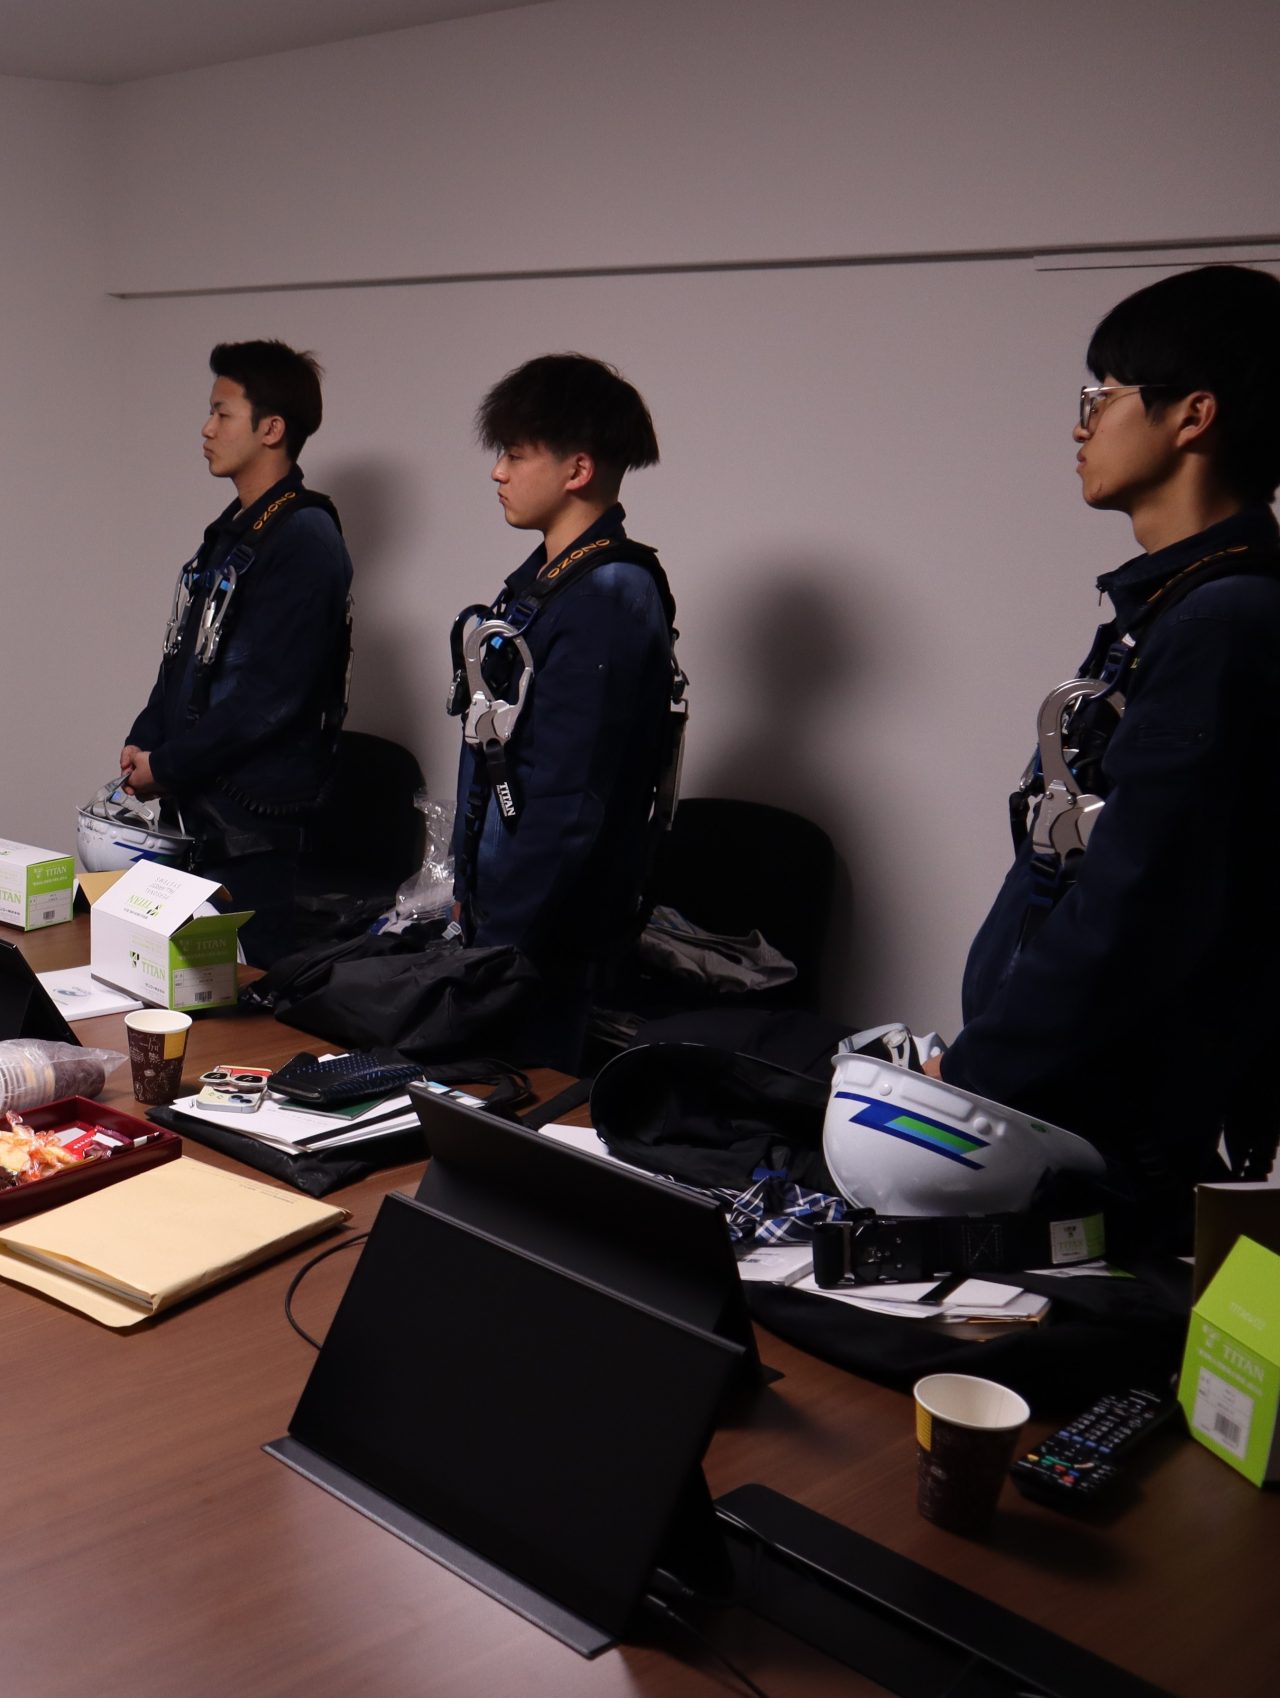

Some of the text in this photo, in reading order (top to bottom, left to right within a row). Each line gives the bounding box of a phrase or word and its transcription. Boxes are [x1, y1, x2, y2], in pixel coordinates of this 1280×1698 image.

[252, 490, 298, 531] OZONO
[547, 538, 611, 580] OZONO
[499, 781, 517, 816] TITAN
[142, 960, 166, 981] TITAN
[1223, 1344, 1265, 1383] TITAN
